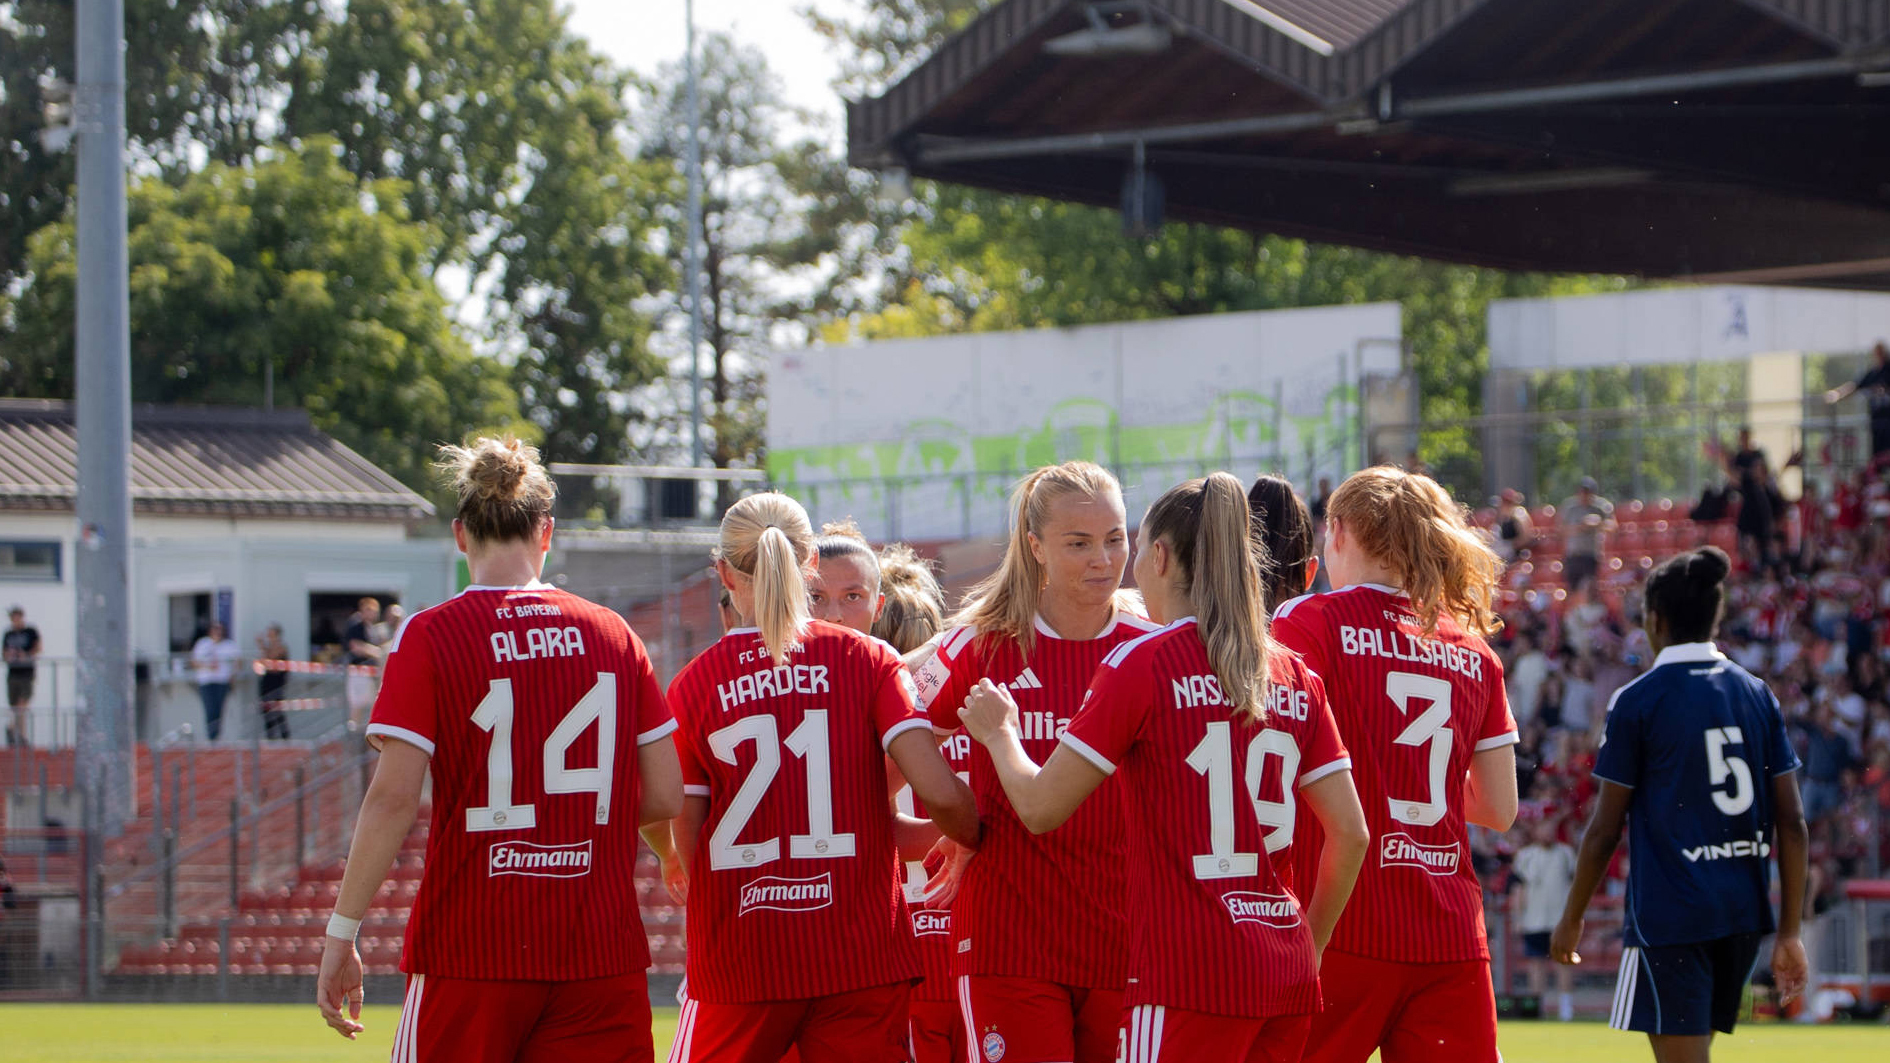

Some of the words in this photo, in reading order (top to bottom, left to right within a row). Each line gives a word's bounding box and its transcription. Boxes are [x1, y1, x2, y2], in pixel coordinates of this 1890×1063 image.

[495, 607, 513, 619] FC
[515, 604, 562, 618] BAYERN
[1383, 610, 1398, 622] FC
[490, 626, 585, 662] ALARA
[739, 650, 755, 664] FC
[1341, 626, 1482, 681] BALLISAGER
[717, 665, 830, 712] HARDER
[466, 671, 617, 832] 14
[1704, 726, 1754, 816] 5
[708, 709, 856, 871] 21
[1185, 721, 1301, 879] 19
[493, 847, 589, 869] Ehrmann
[744, 882, 829, 906] Ehrmann
